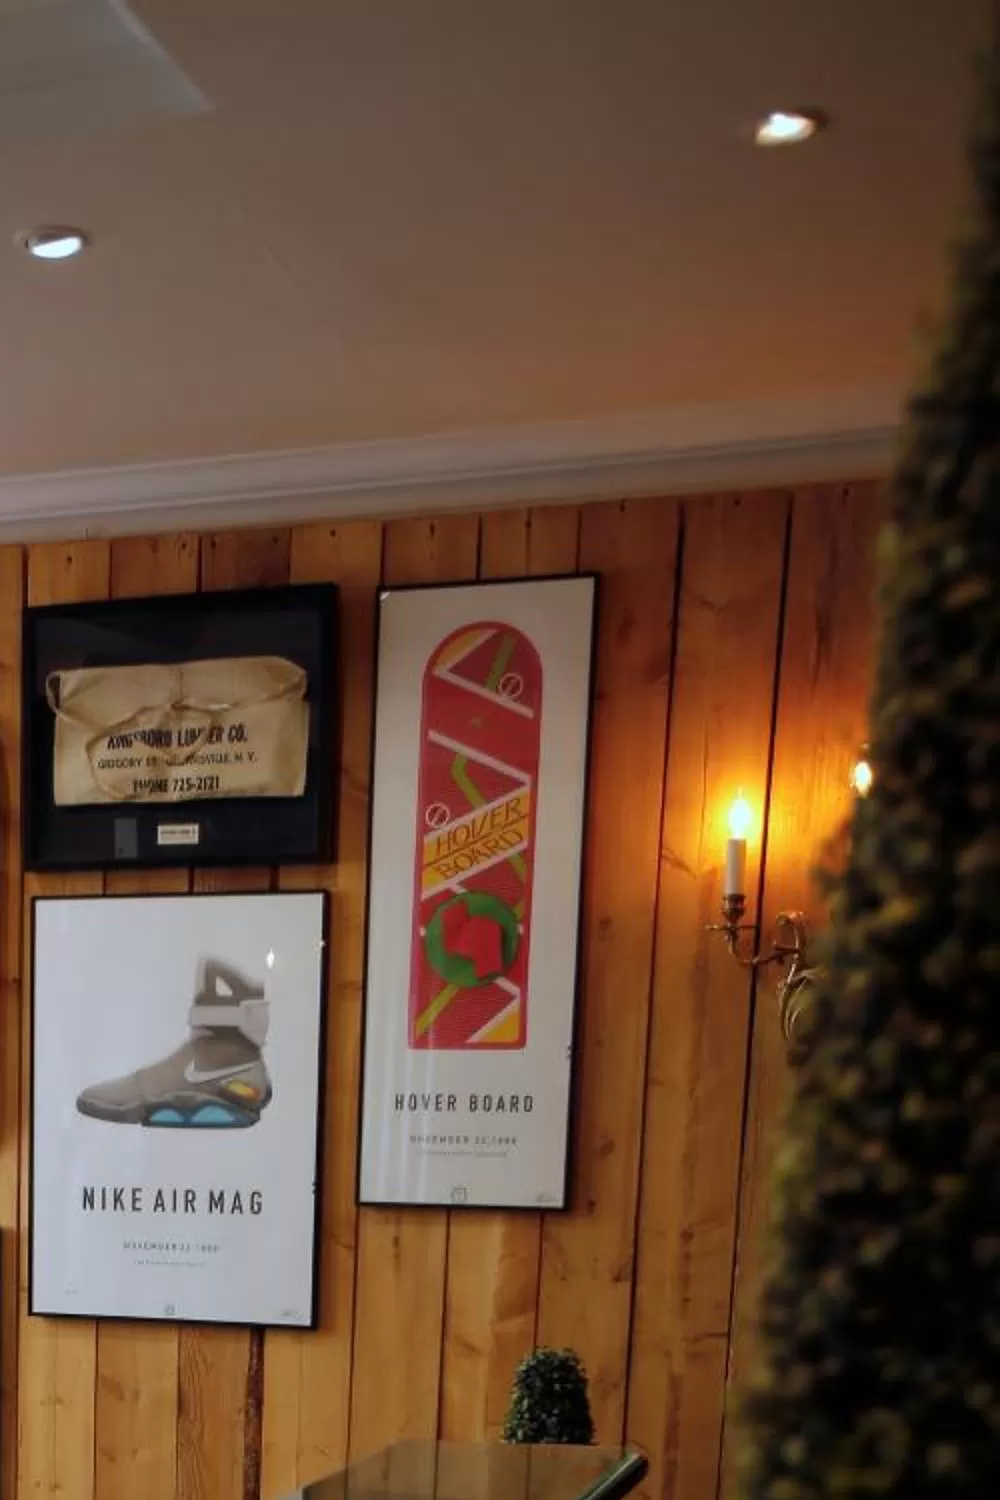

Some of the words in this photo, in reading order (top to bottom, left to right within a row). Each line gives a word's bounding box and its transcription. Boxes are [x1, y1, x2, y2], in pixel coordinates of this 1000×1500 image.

[436, 798, 526, 858] HOVER
[395, 1093, 457, 1113] HOVER
[469, 1095, 533, 1113] BOARD
[83, 1186, 143, 1213] NIKE
[153, 1188, 196, 1213] AIR
[208, 1189, 264, 1215] MAG
